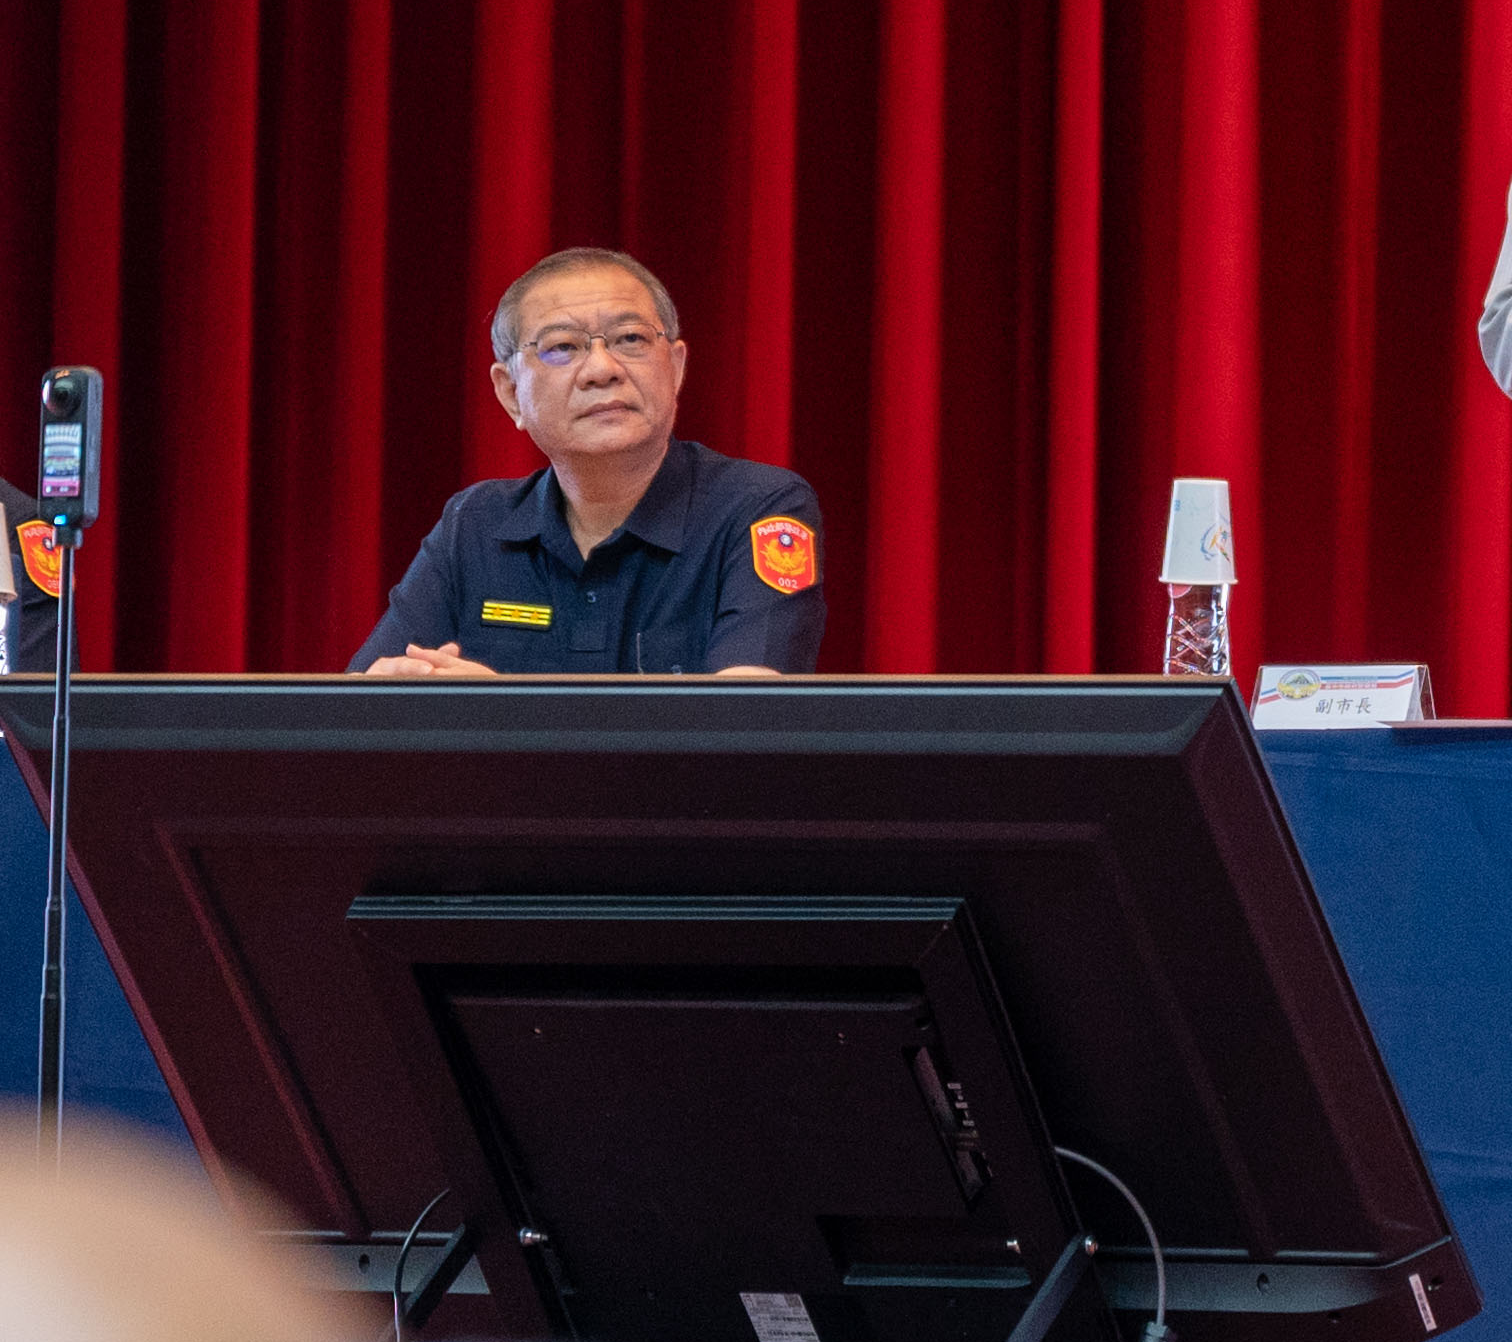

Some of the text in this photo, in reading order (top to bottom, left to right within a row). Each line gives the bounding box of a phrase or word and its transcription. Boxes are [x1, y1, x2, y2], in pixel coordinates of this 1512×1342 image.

[778, 577, 798, 589] 002
[1315, 697, 1372, 714] 副市長
